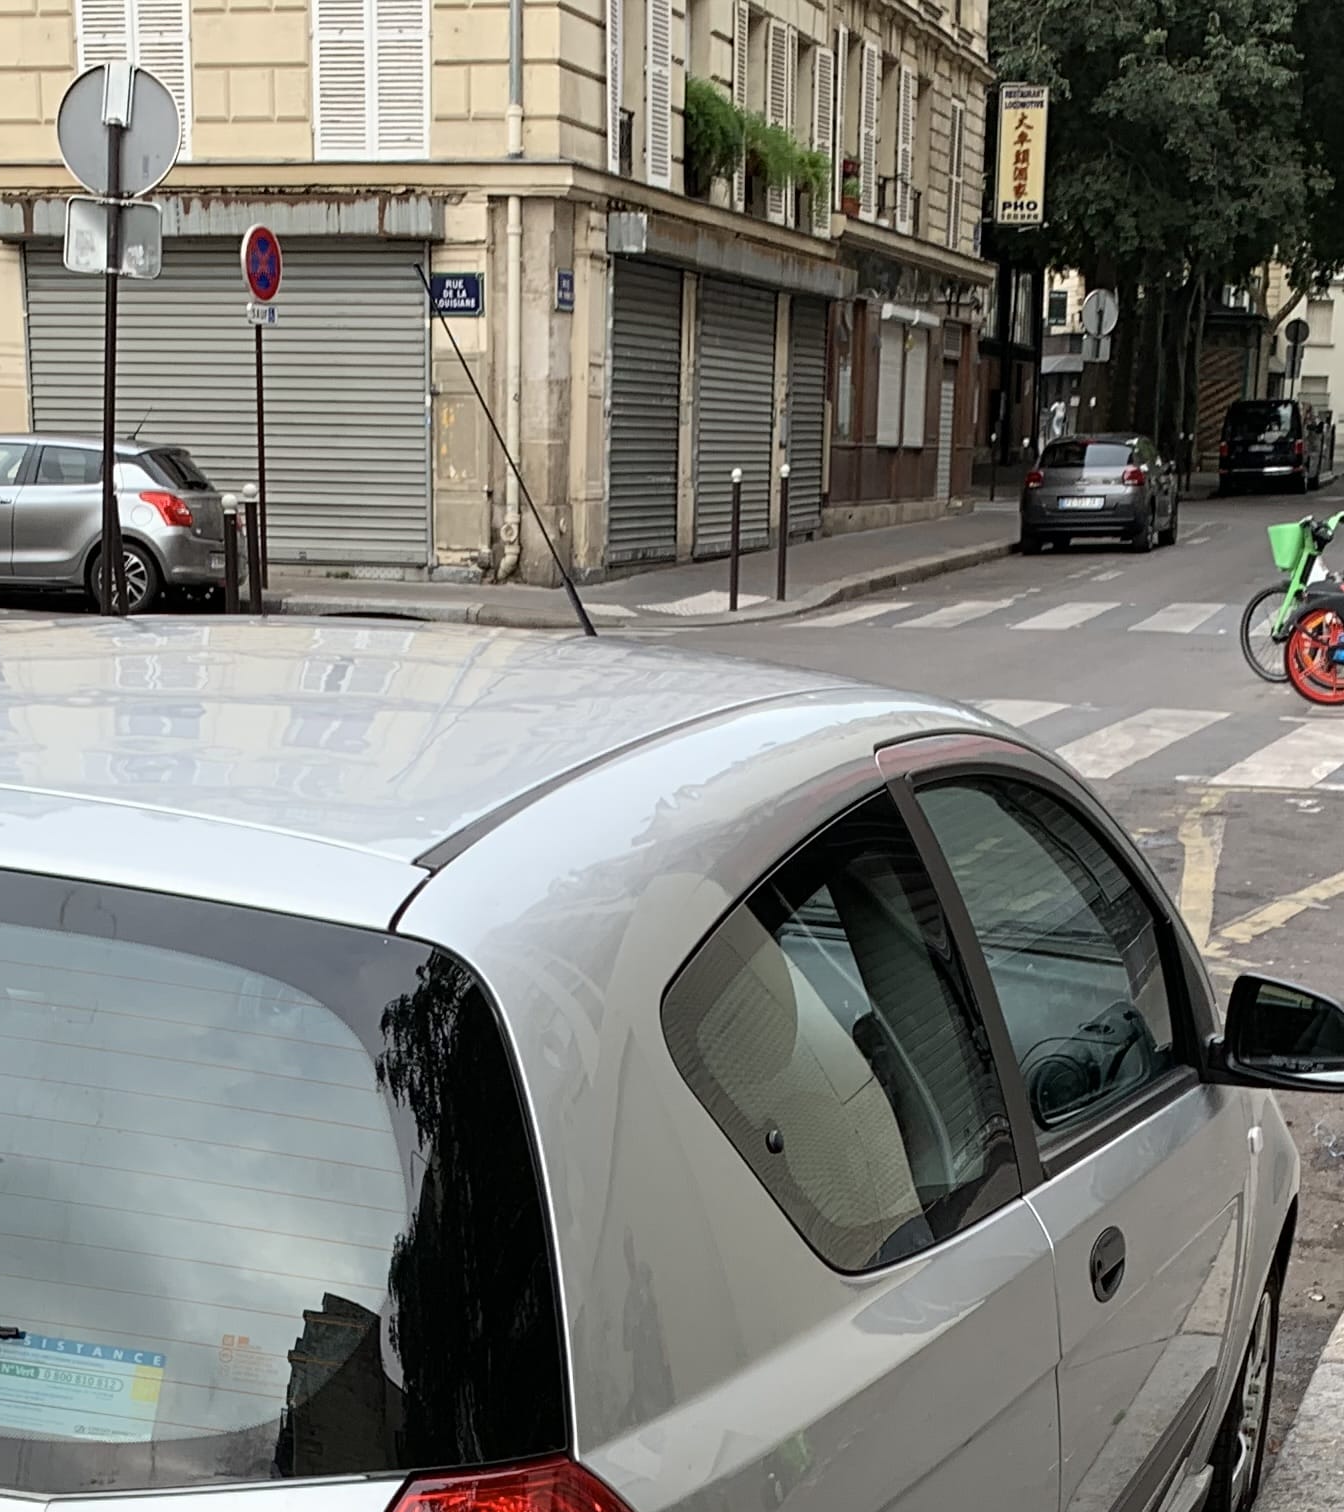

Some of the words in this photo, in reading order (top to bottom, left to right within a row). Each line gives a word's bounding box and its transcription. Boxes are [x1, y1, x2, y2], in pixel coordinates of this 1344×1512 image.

[1002, 201, 1038, 212] PHO
[445, 279, 464, 289] RUE
[442, 289, 454, 298] DE
[456, 289, 467, 298] LA
[15, 1365, 35, 1377] Vert
